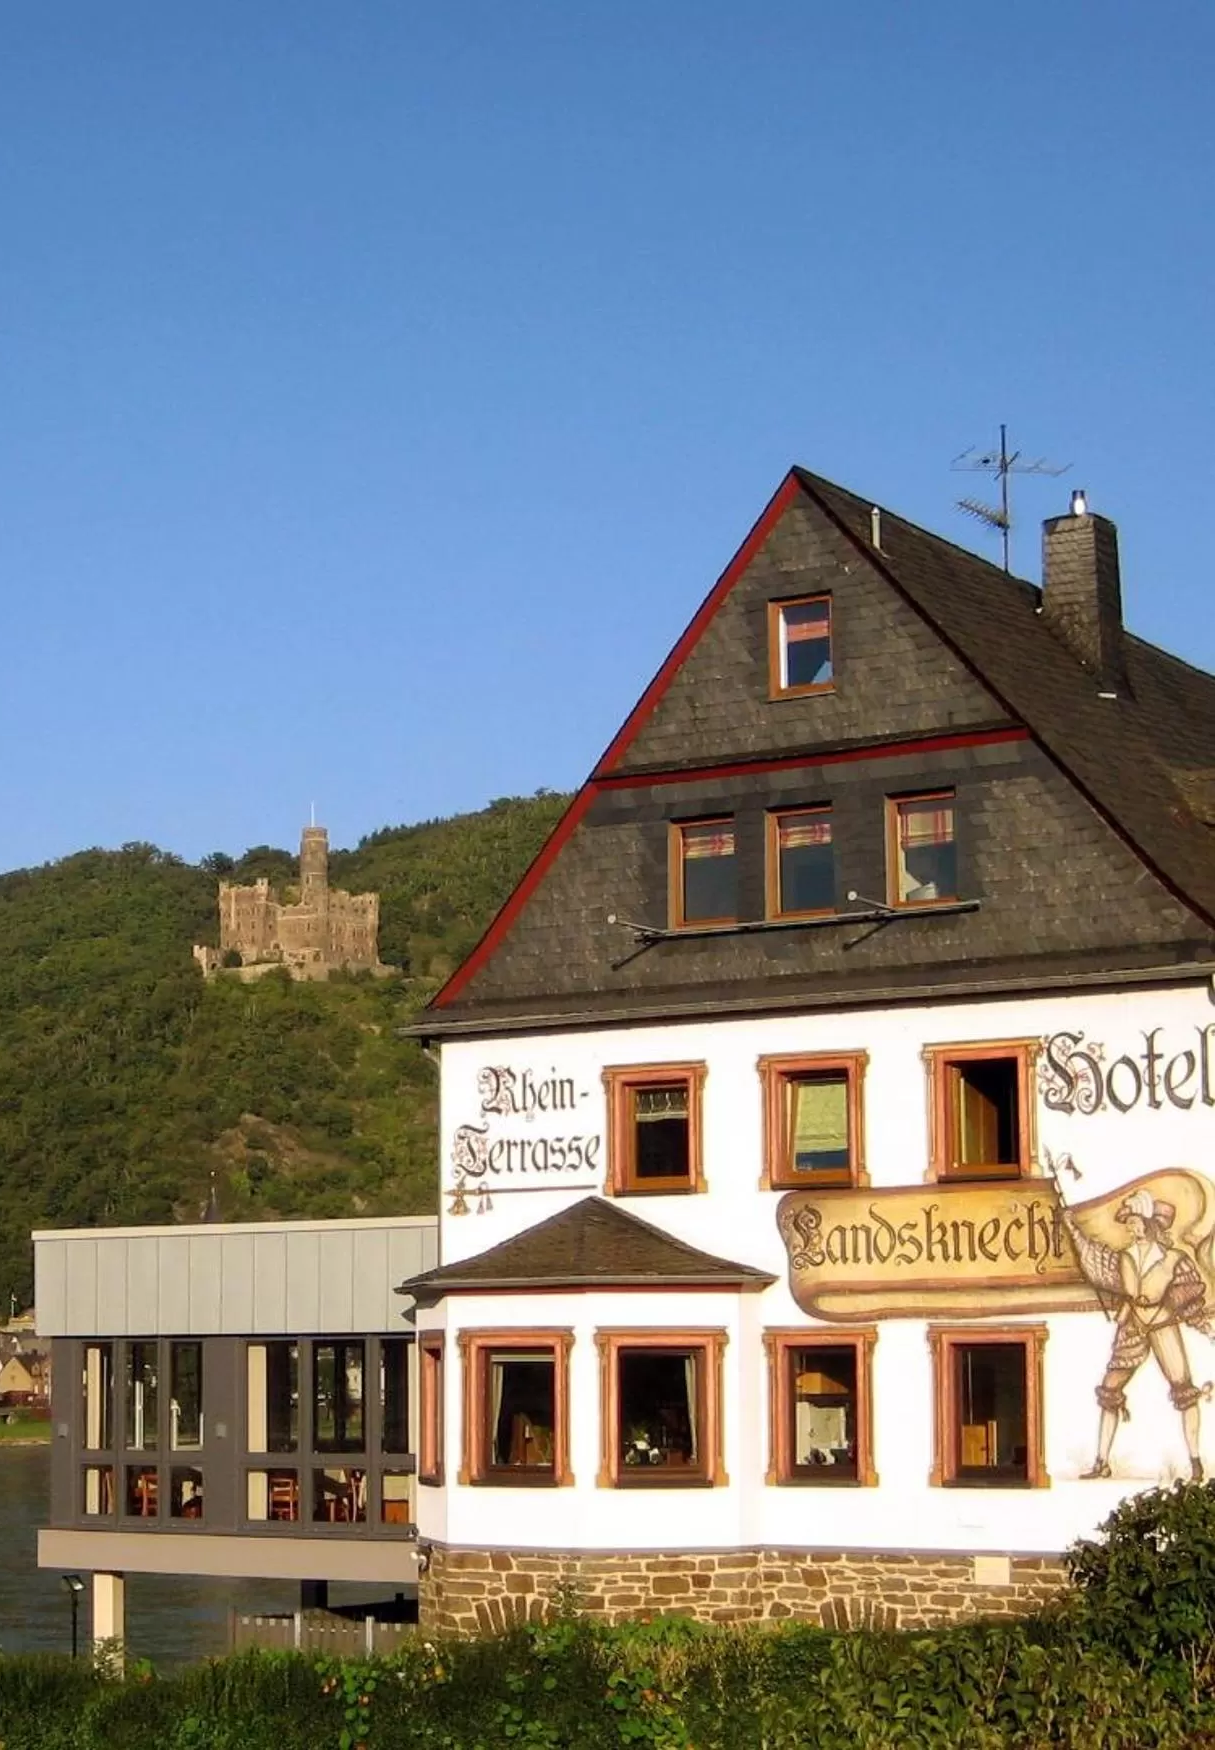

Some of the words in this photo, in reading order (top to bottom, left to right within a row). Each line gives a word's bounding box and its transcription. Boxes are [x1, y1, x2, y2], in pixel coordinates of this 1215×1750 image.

[477, 1065, 589, 1121] Rhein-
[1039, 1023, 1215, 1116] Hotel
[452, 1123, 600, 1179] Terrasse
[788, 1200, 1067, 1274] Landsknecht
